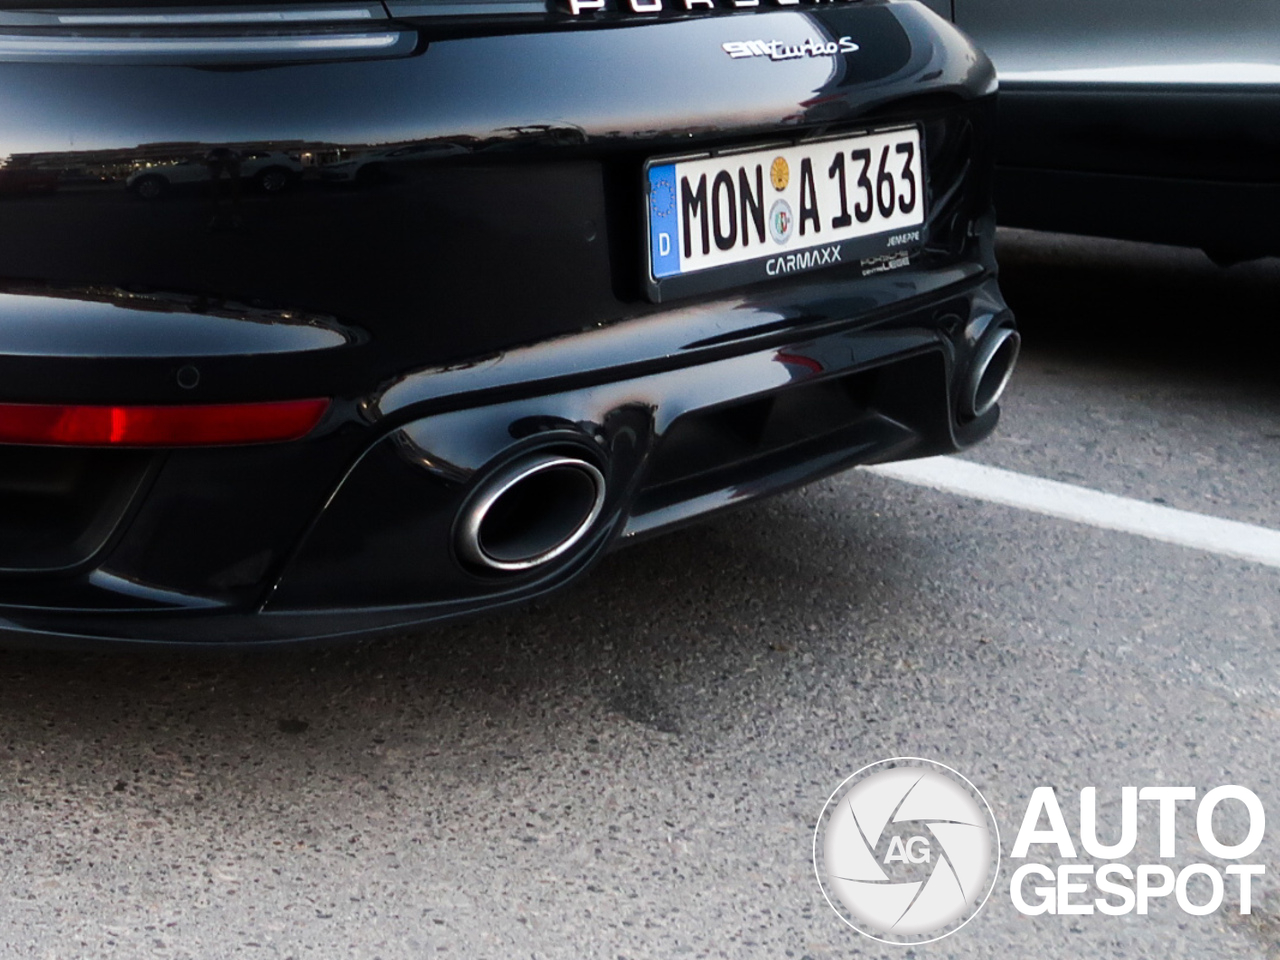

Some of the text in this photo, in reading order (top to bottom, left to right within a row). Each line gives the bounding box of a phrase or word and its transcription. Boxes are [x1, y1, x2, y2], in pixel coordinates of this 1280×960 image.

[681, 141, 917, 258] MON A 1363
[659, 232, 671, 256] D
[766, 245, 842, 276] CARMAXX
